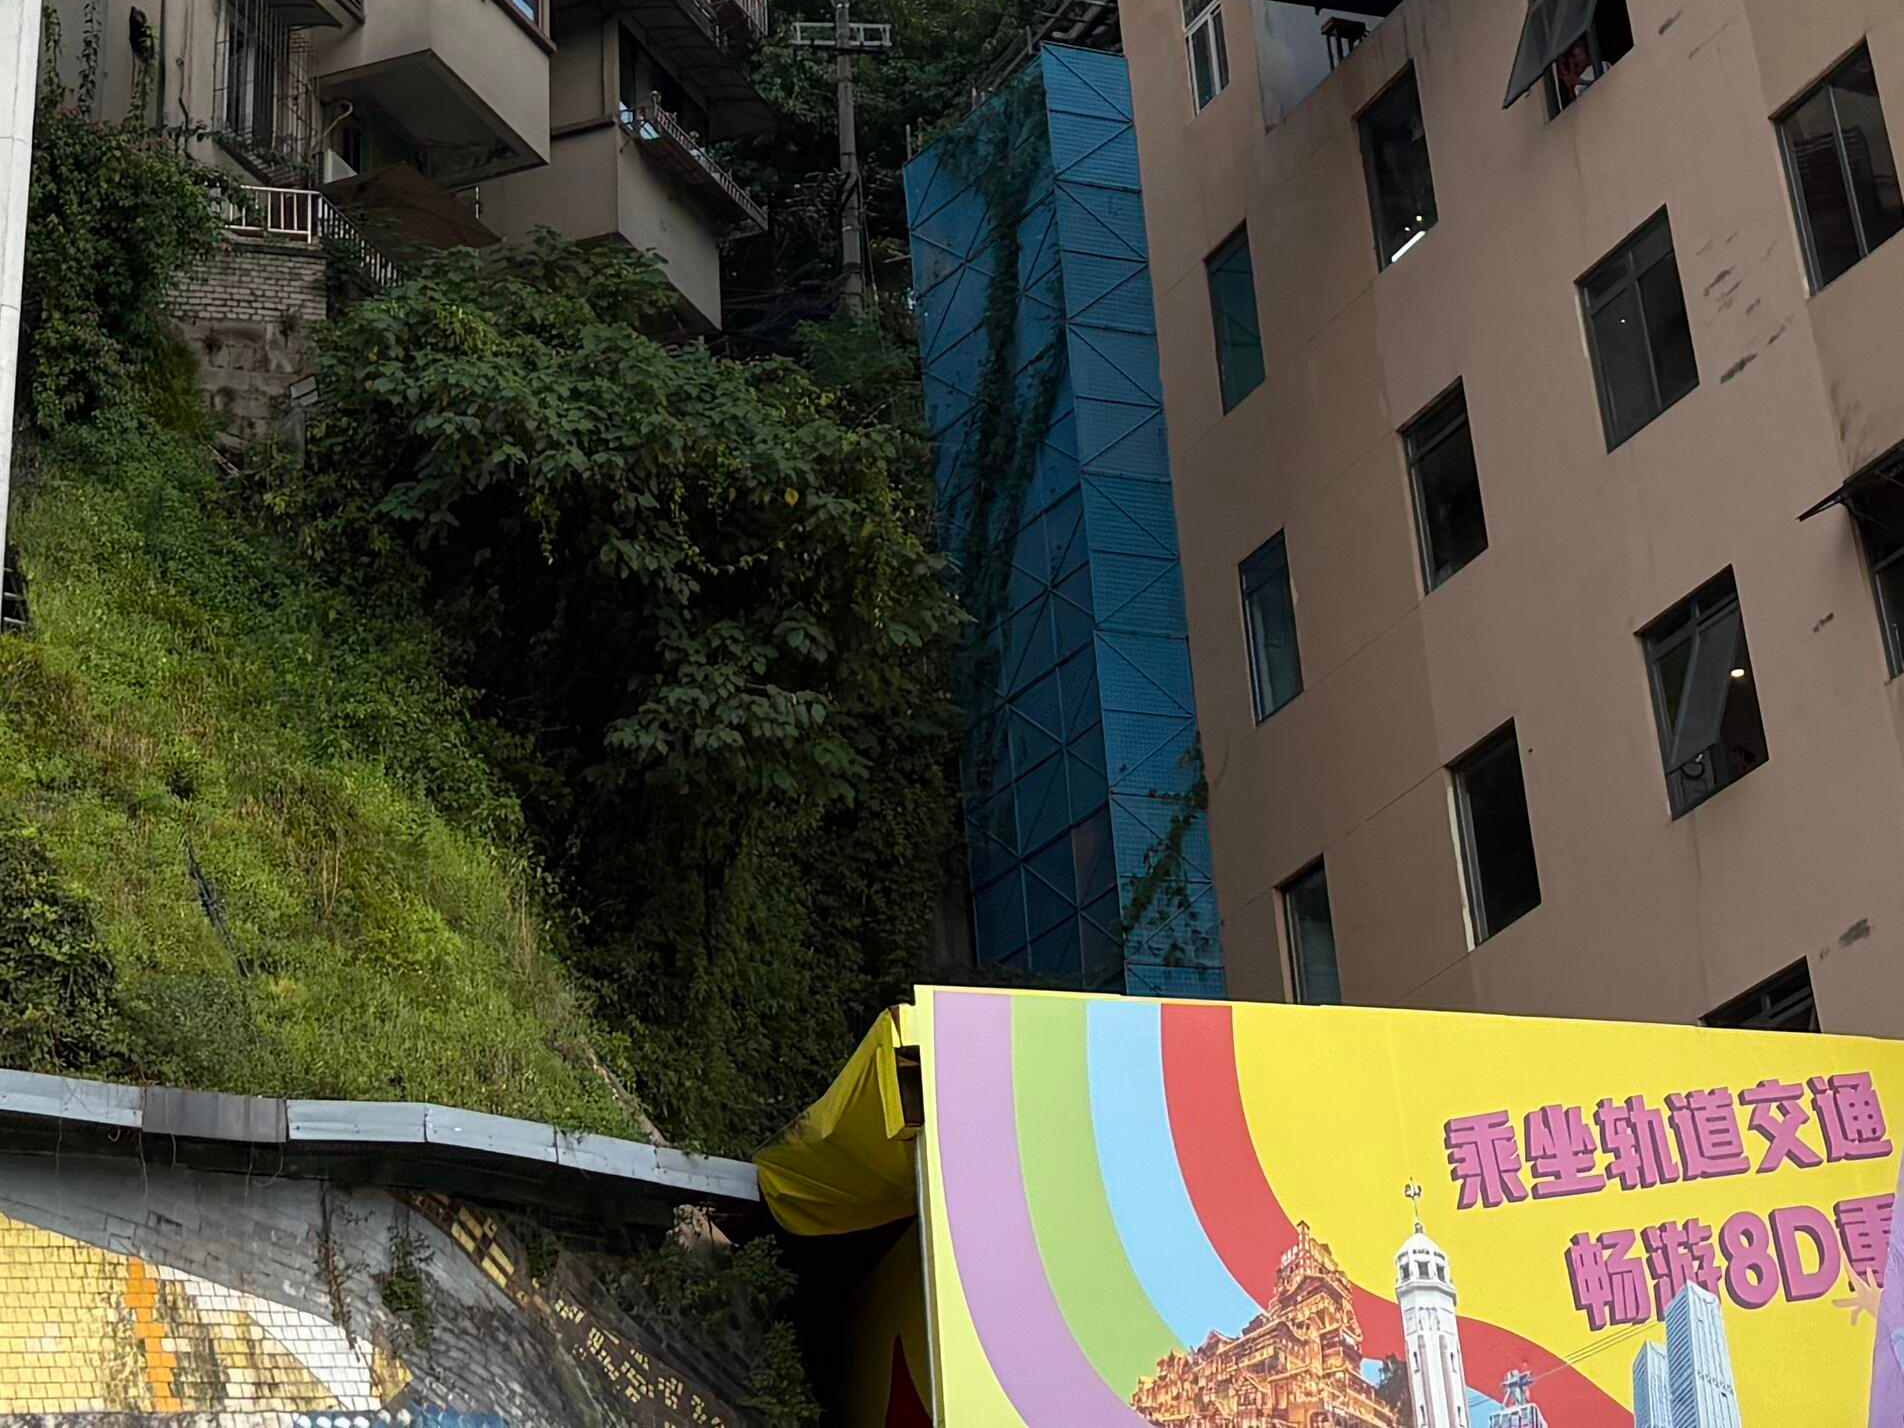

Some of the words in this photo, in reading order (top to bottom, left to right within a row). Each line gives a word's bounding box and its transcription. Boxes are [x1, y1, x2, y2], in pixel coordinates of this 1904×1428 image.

[1443, 1071, 1895, 1211] 乘坐轨道交通
